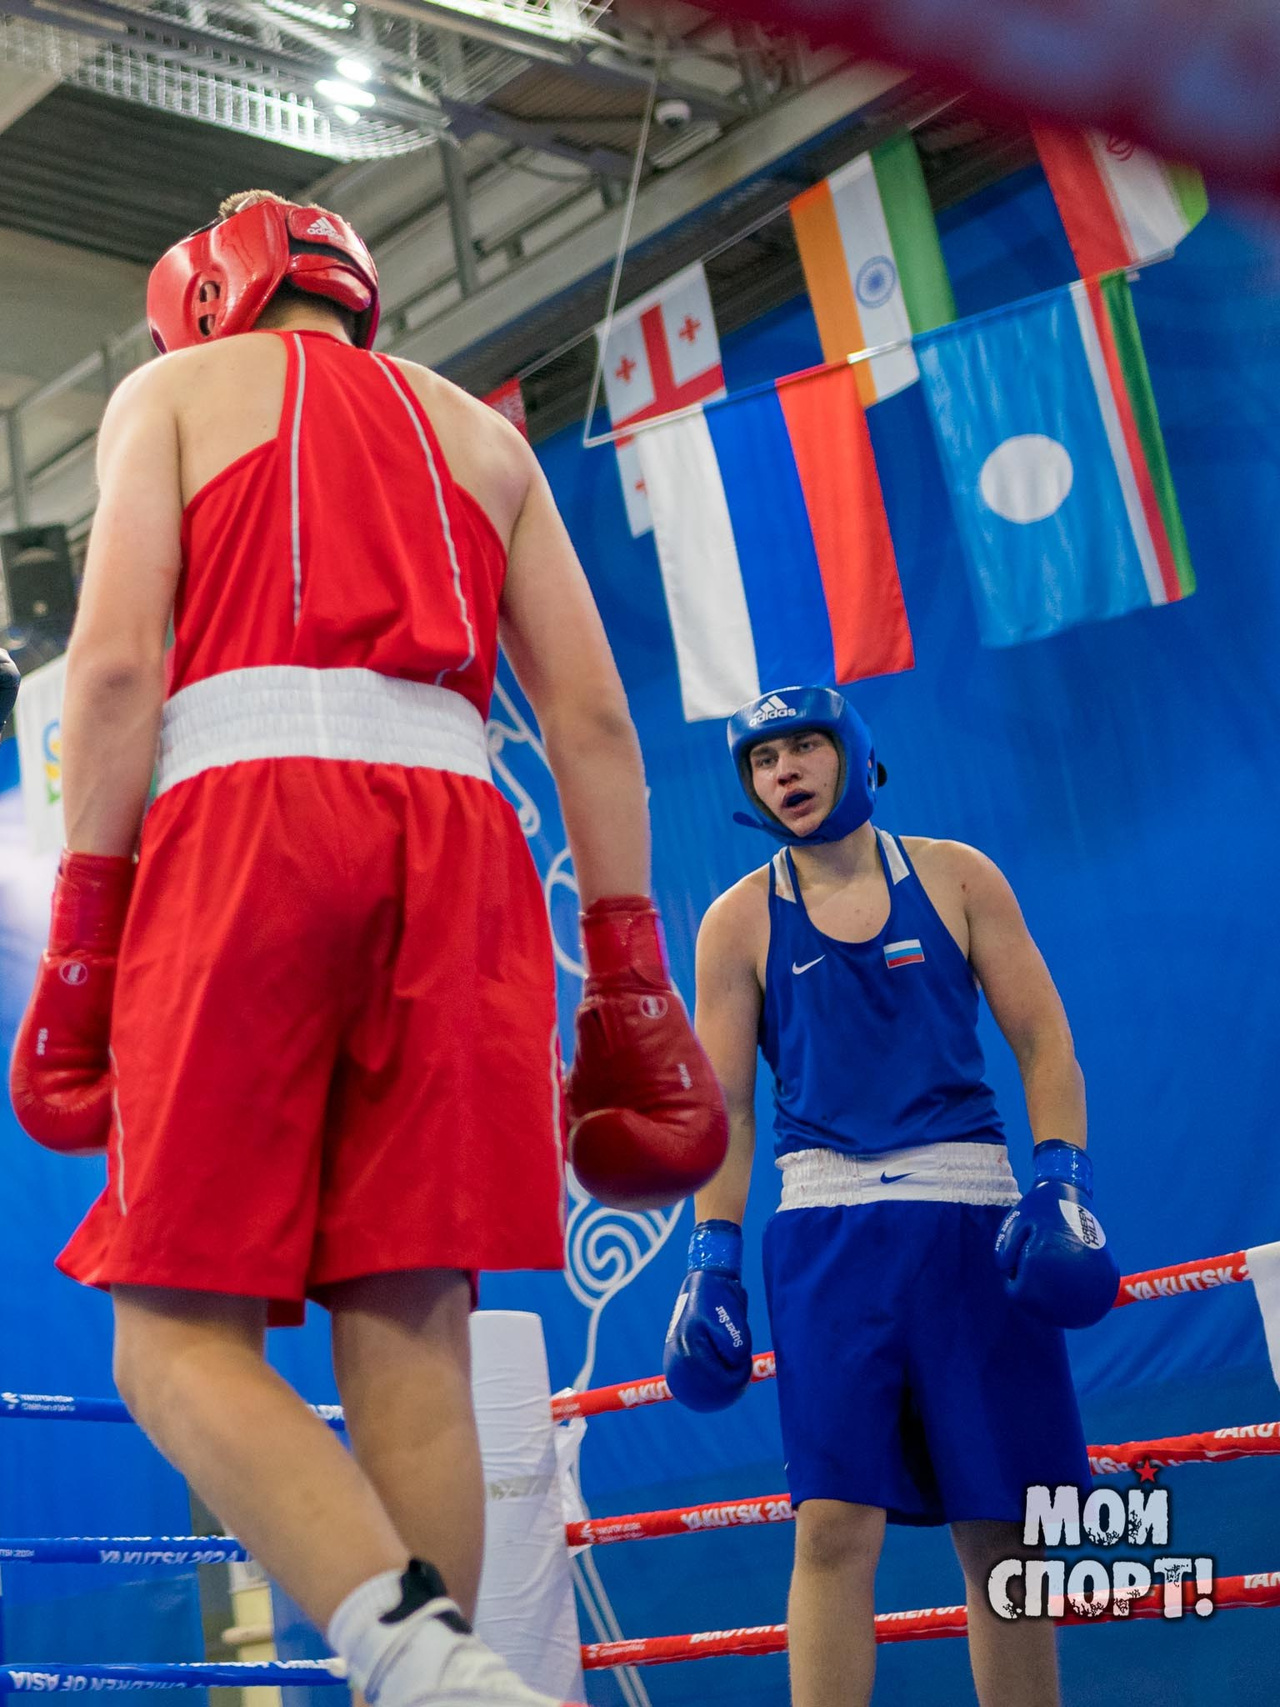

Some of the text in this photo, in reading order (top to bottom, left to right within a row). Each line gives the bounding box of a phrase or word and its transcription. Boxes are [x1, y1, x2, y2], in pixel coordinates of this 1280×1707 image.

[748, 708, 797, 728] adidas
[1076, 1205, 1091, 1245] GREEN
[1084, 1216, 1100, 1247] HILL
[1125, 1266, 1236, 1301] YAKUTSK
[715, 1305, 743, 1348] Super Star
[680, 1502, 766, 1531] YAKUTSK
[8, 1669, 60, 1691] ASIA
[59, 1674, 89, 1692] OF
